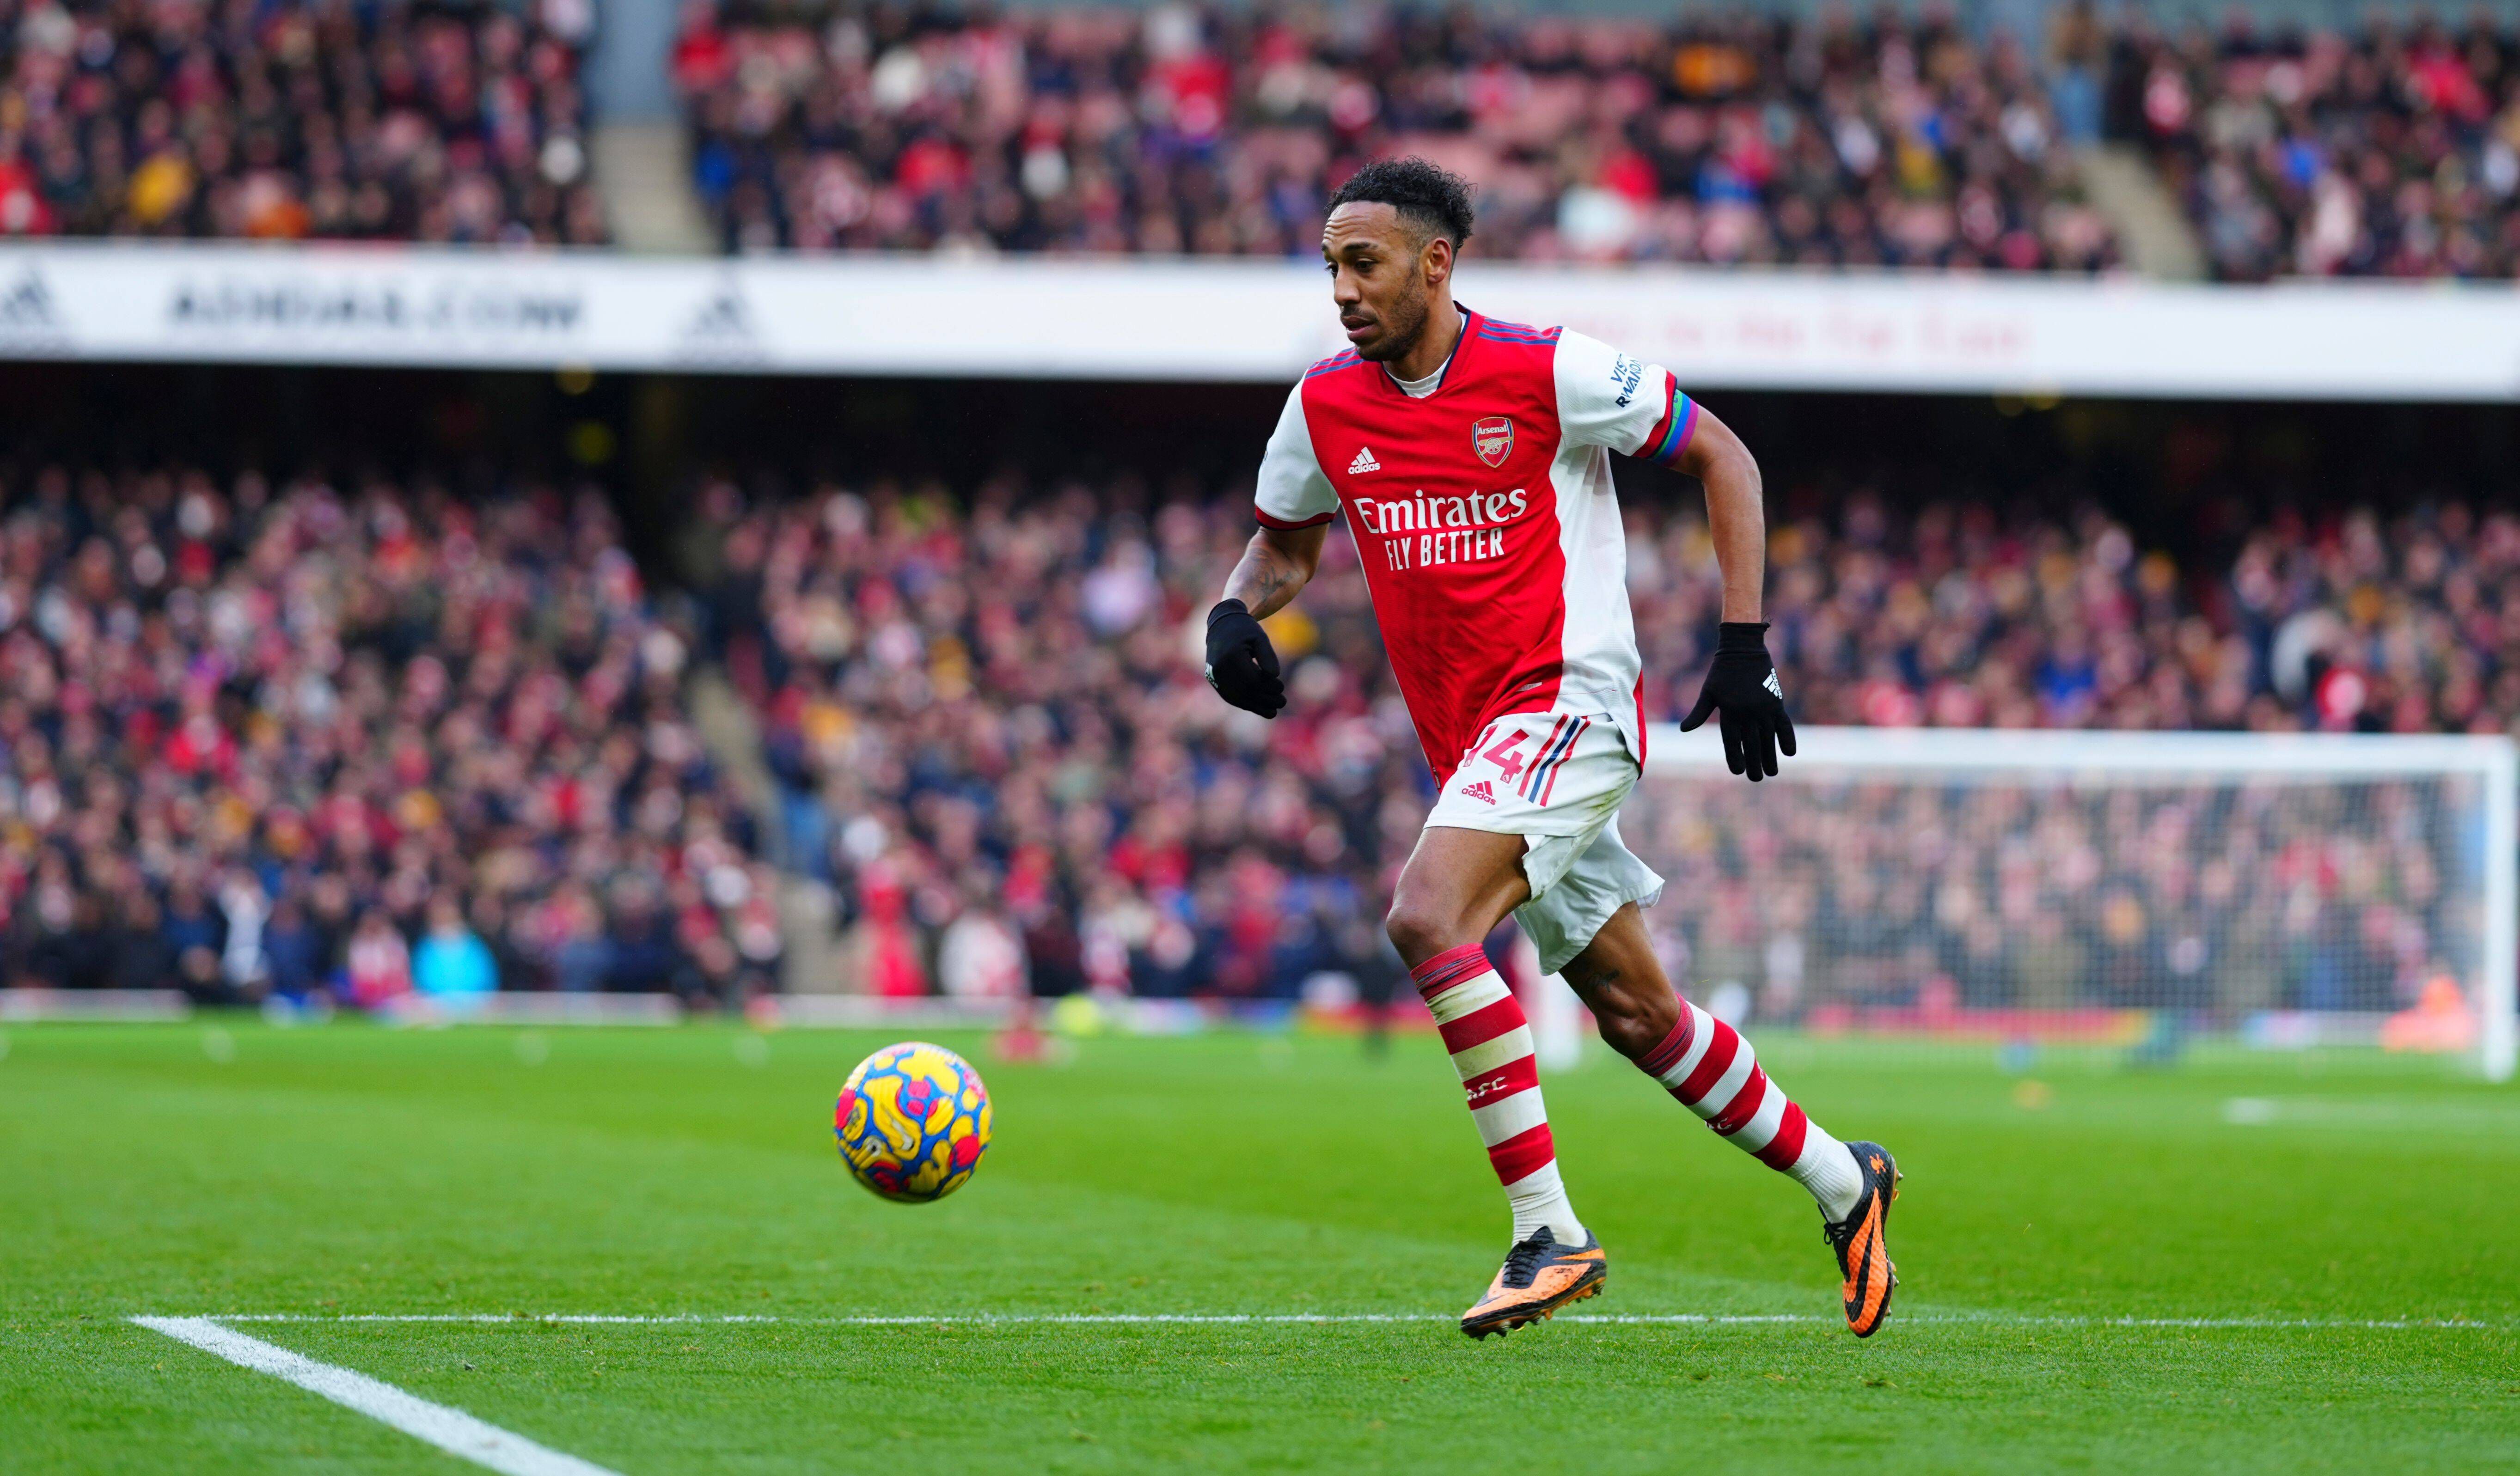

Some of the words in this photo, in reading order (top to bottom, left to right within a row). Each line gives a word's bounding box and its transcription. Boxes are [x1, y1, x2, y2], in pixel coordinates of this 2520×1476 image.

[1478, 424, 1507, 434] Arsenal
[1348, 463, 1381, 474] adidas
[1353, 489, 1527, 533] Emirates
[1385, 537, 1411, 571] FLY
[1420, 527, 1505, 567] BETTER
[1463, 724, 1529, 784] 14
[1462, 788, 1496, 805] adidas
